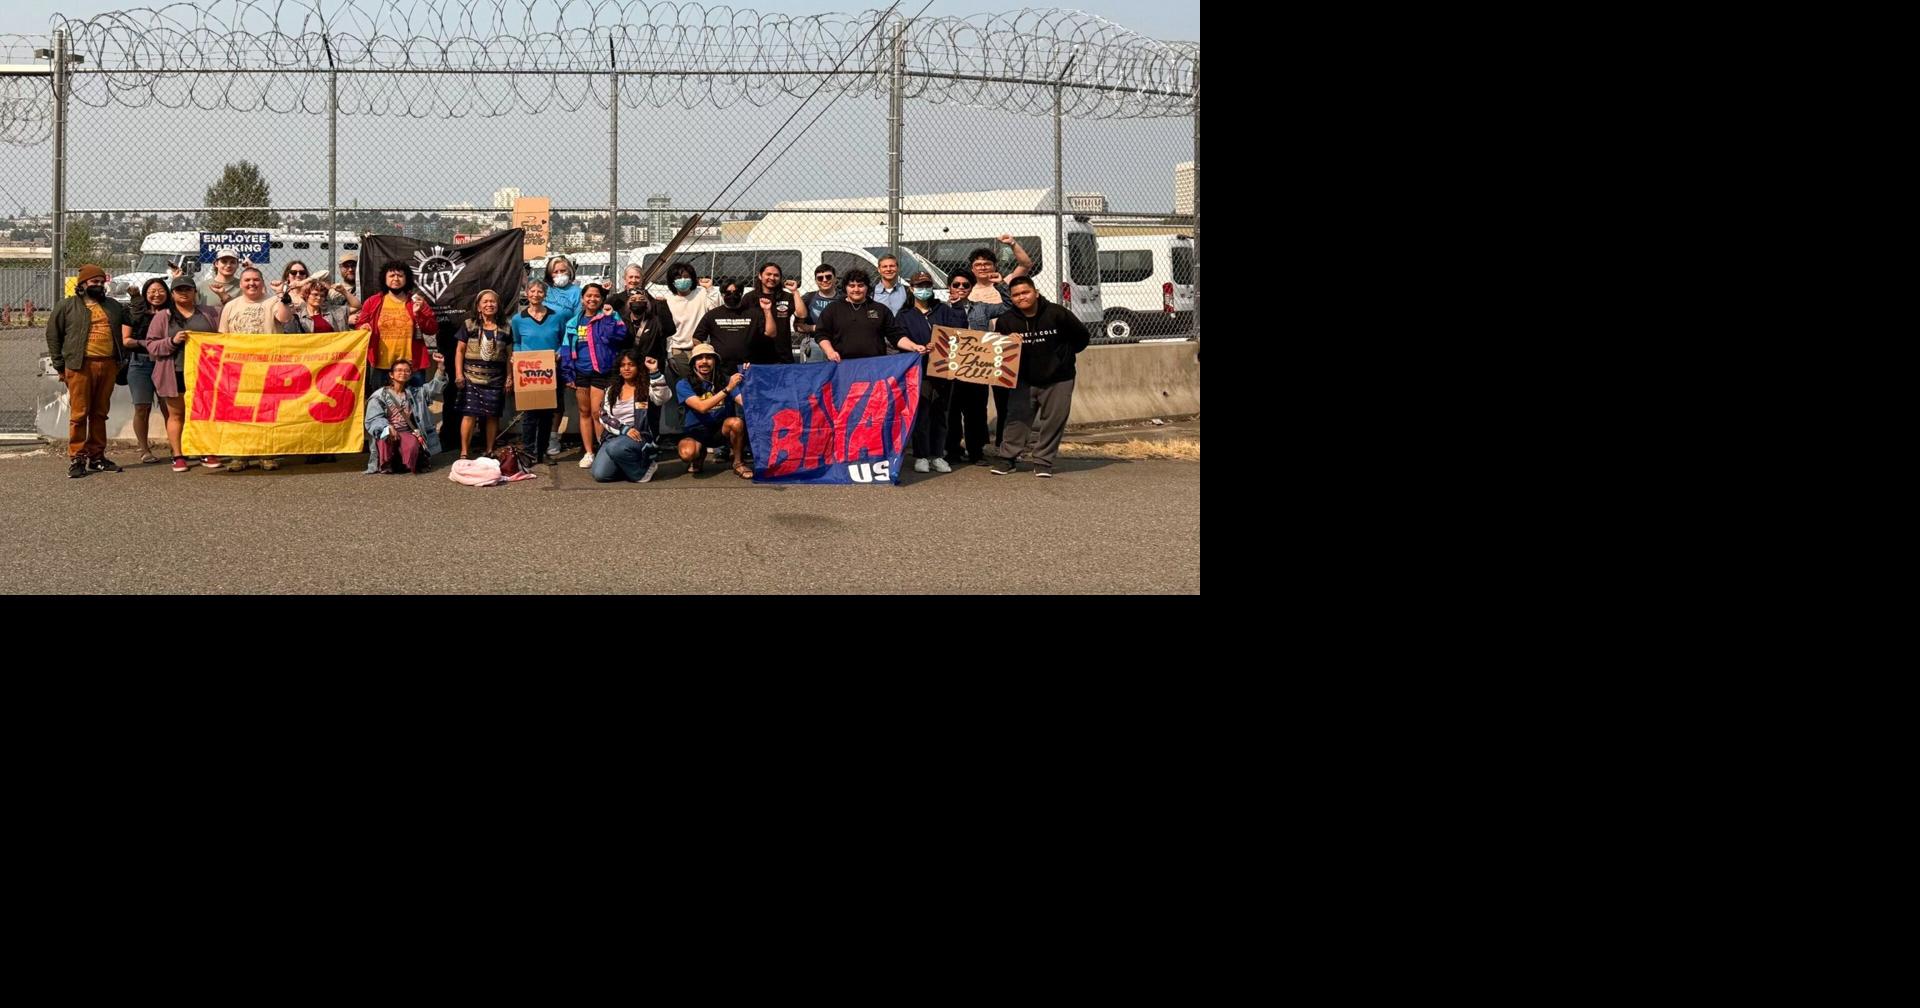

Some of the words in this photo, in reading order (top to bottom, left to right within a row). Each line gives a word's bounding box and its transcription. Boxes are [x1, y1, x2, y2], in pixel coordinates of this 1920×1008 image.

[203, 234, 267, 243] EMPLOYEE
[208, 244, 262, 252] PARKING
[958, 352, 995, 368] Them
[523, 368, 553, 378] TATAY
[190, 343, 361, 424] ILPS
[763, 365, 920, 478] BAYAN
[848, 460, 890, 483] US
